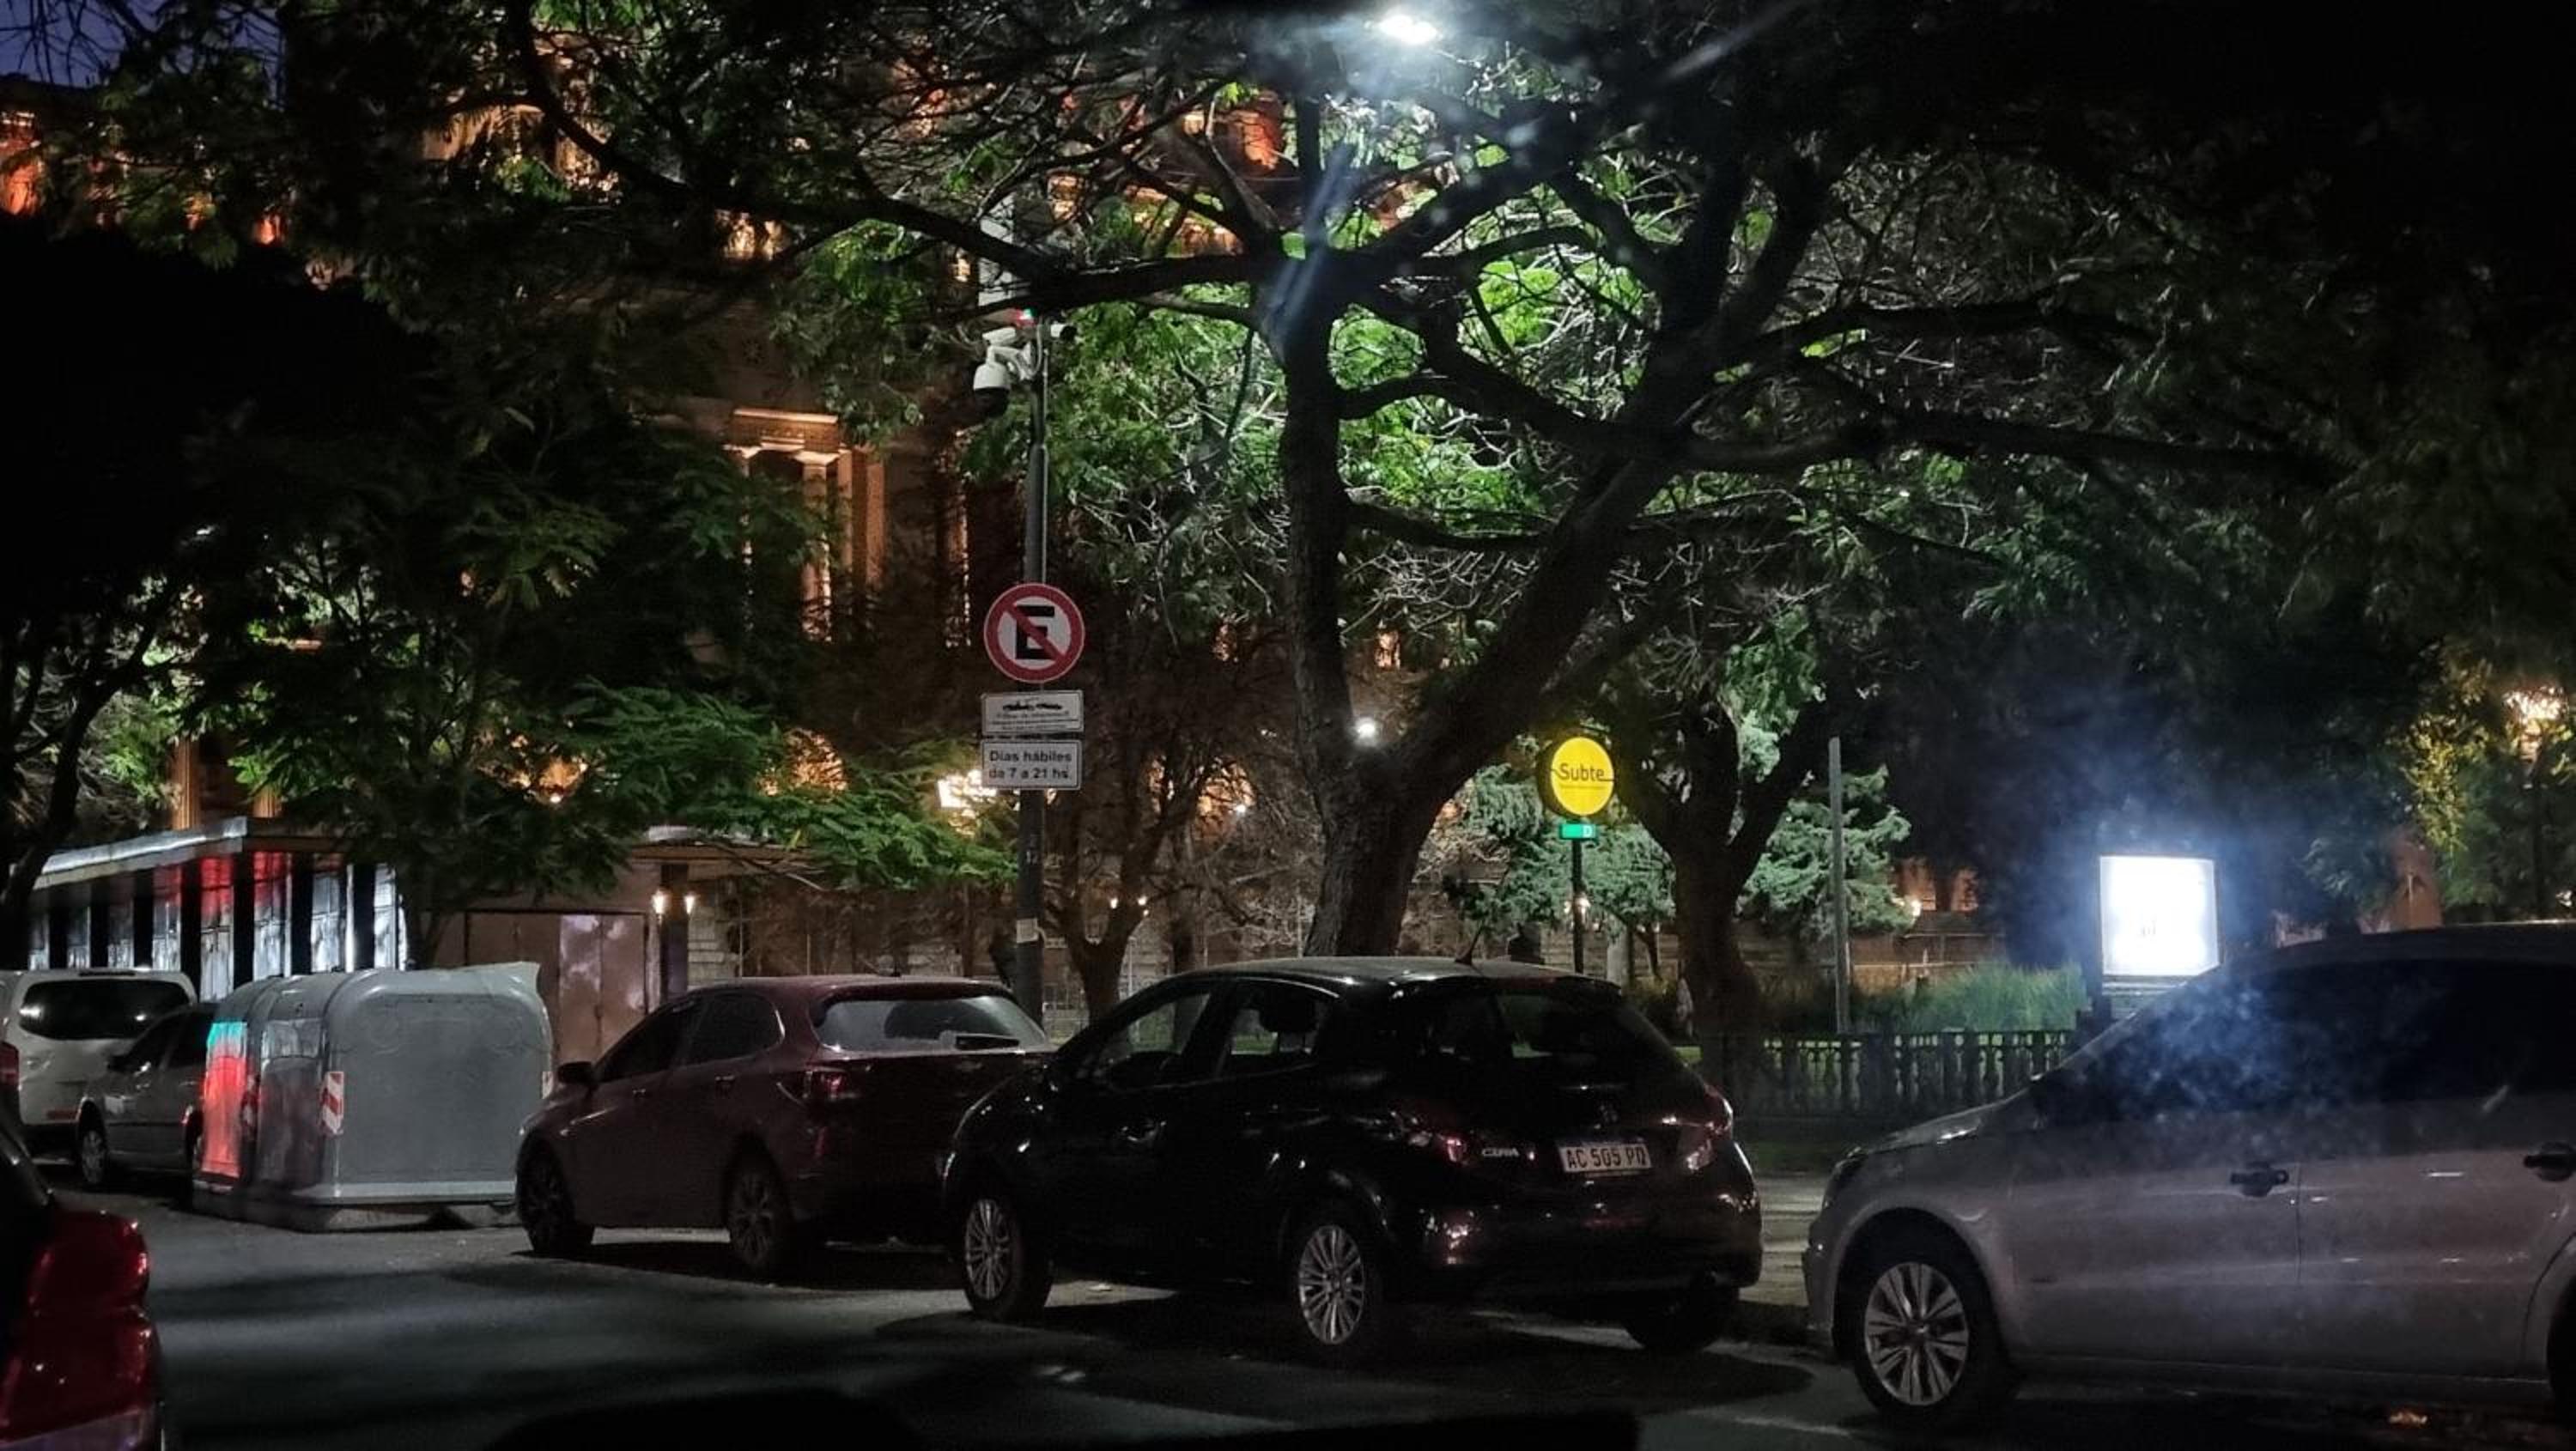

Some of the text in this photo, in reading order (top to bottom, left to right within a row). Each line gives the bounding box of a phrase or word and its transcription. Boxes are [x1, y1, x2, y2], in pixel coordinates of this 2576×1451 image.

[988, 767, 1005, 779] de
[1008, 767, 1017, 779] 7
[1021, 769, 1029, 779] a
[1032, 767, 1047, 780] 21
[1558, 762, 1605, 782] Subte
[1566, 1148, 1588, 1169] AC
[1593, 1147, 1622, 1167] 505
